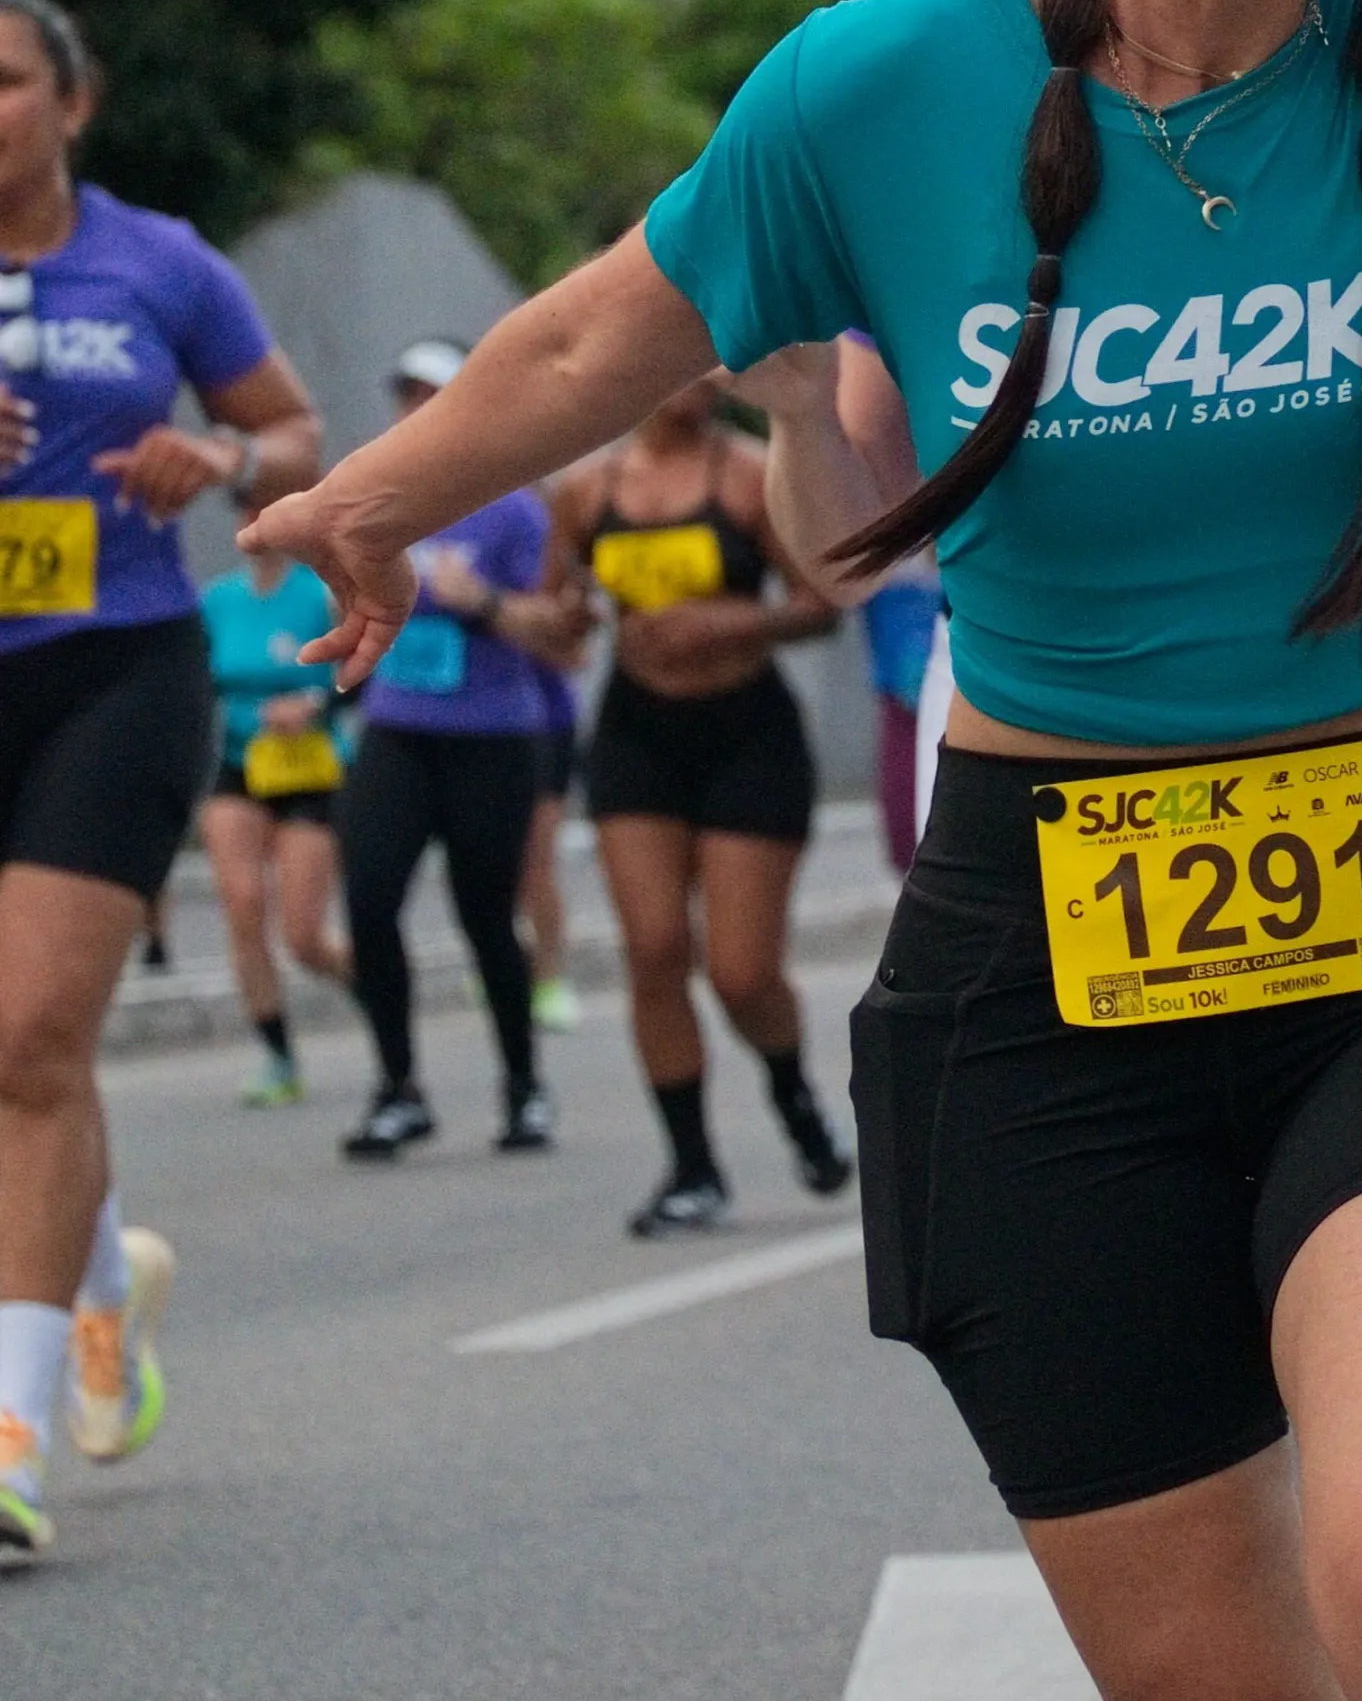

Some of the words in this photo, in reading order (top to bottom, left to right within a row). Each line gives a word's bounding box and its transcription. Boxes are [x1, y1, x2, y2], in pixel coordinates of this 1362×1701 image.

[1022, 412, 1153, 440] RATONA
[1191, 397, 1257, 425] SÃO
[1269, 377, 1353, 415] JOSÉ
[1303, 761, 1359, 783] OSCAR
[1077, 776, 1244, 836] SJC42K
[1098, 831, 1160, 846] MARATONA
[1067, 899, 1084, 920] C
[1187, 958, 1250, 979] JESSICA
[1253, 948, 1315, 970] CAMPOS
[1263, 973, 1331, 995] FEMININO
[1147, 996, 1185, 1014] Sou
[1188, 987, 1228, 1010] 10k!
